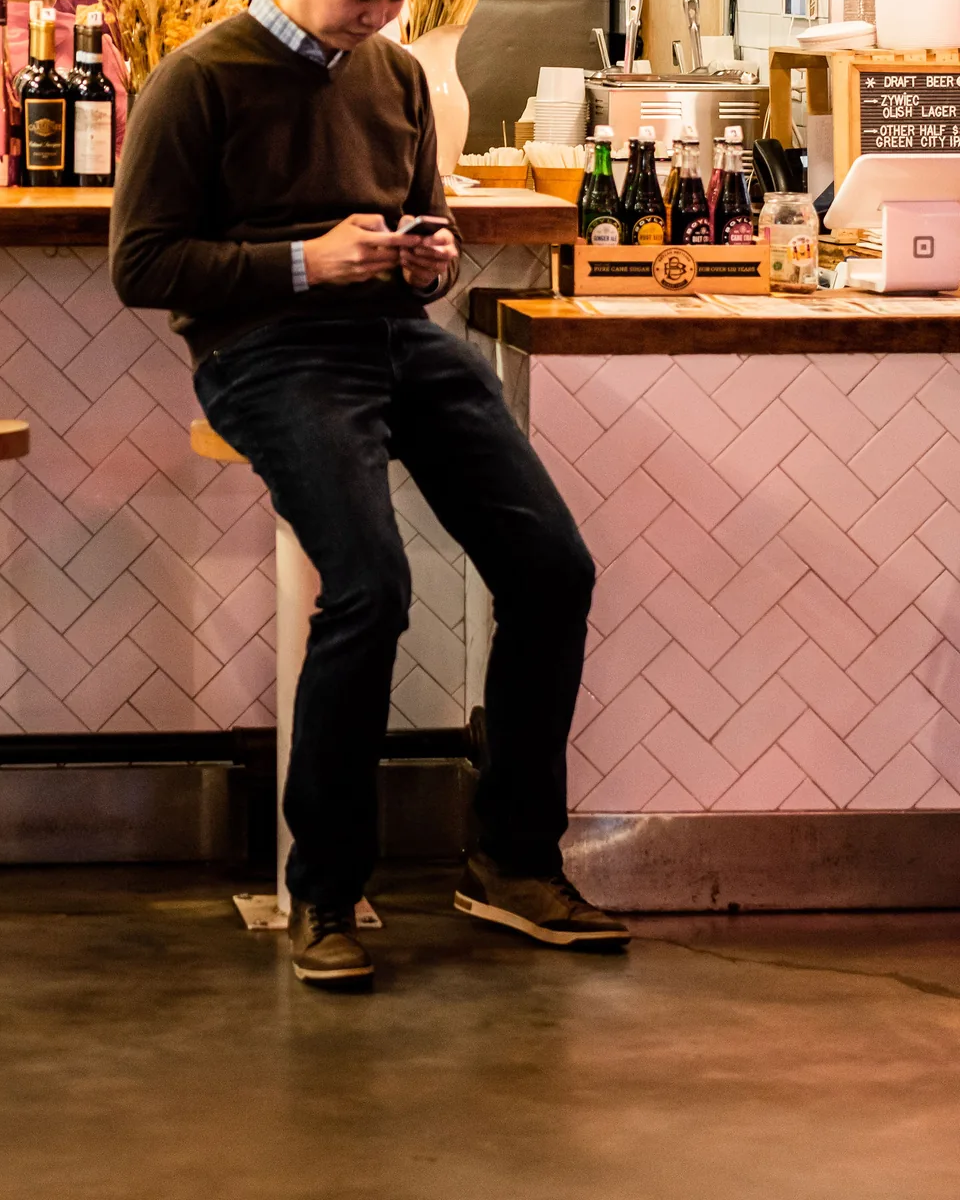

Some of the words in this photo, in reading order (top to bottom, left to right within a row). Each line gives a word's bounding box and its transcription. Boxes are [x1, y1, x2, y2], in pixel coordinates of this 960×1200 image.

[883, 75, 917, 88] DRAFT
[926, 75, 954, 88] BEER
[882, 106, 913, 119] OLISH
[921, 105, 957, 118] LAGER
[879, 124, 915, 137] OTHER
[919, 124, 946, 136] HALF
[875, 135, 913, 148] GREEN
[920, 136, 946, 148] CITY
